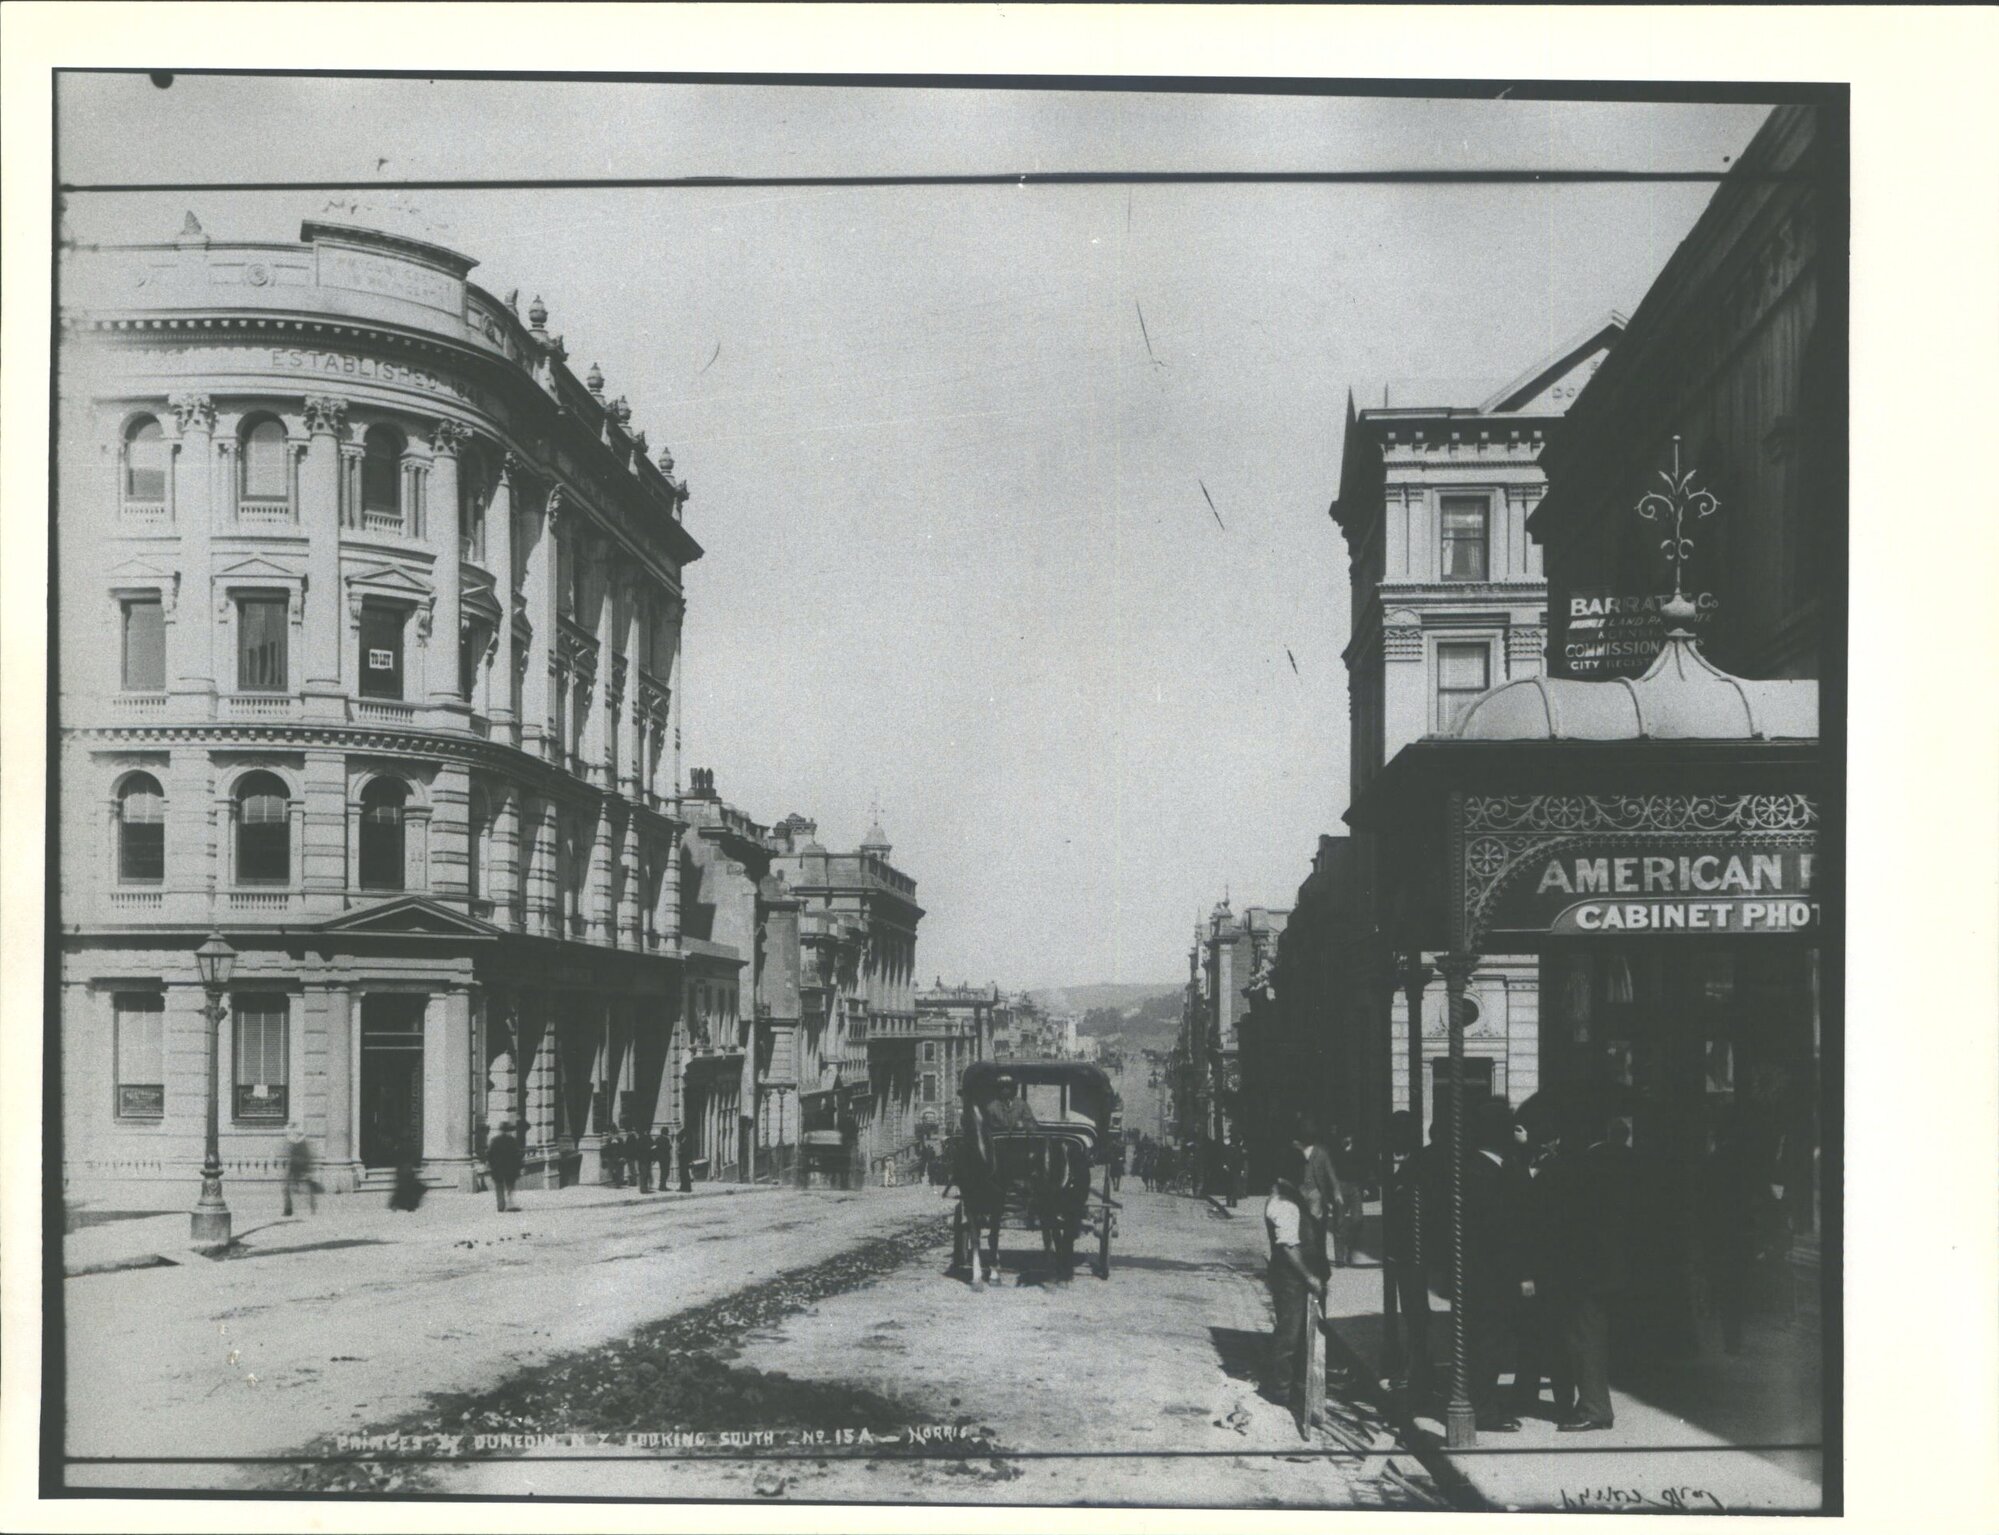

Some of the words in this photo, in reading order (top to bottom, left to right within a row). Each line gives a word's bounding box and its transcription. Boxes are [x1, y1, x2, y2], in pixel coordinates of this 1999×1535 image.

[270, 349, 439, 391] ESTABLISHED
[1608, 616, 1644, 627] LAND
[1564, 639, 1661, 658] COMMISSION
[371, 652, 379, 665] TO
[379, 653, 391, 666] LET
[1569, 659, 1600, 671] CITY
[1536, 854, 1783, 894] AMERICAN
[1575, 903, 1734, 930] CABINET
